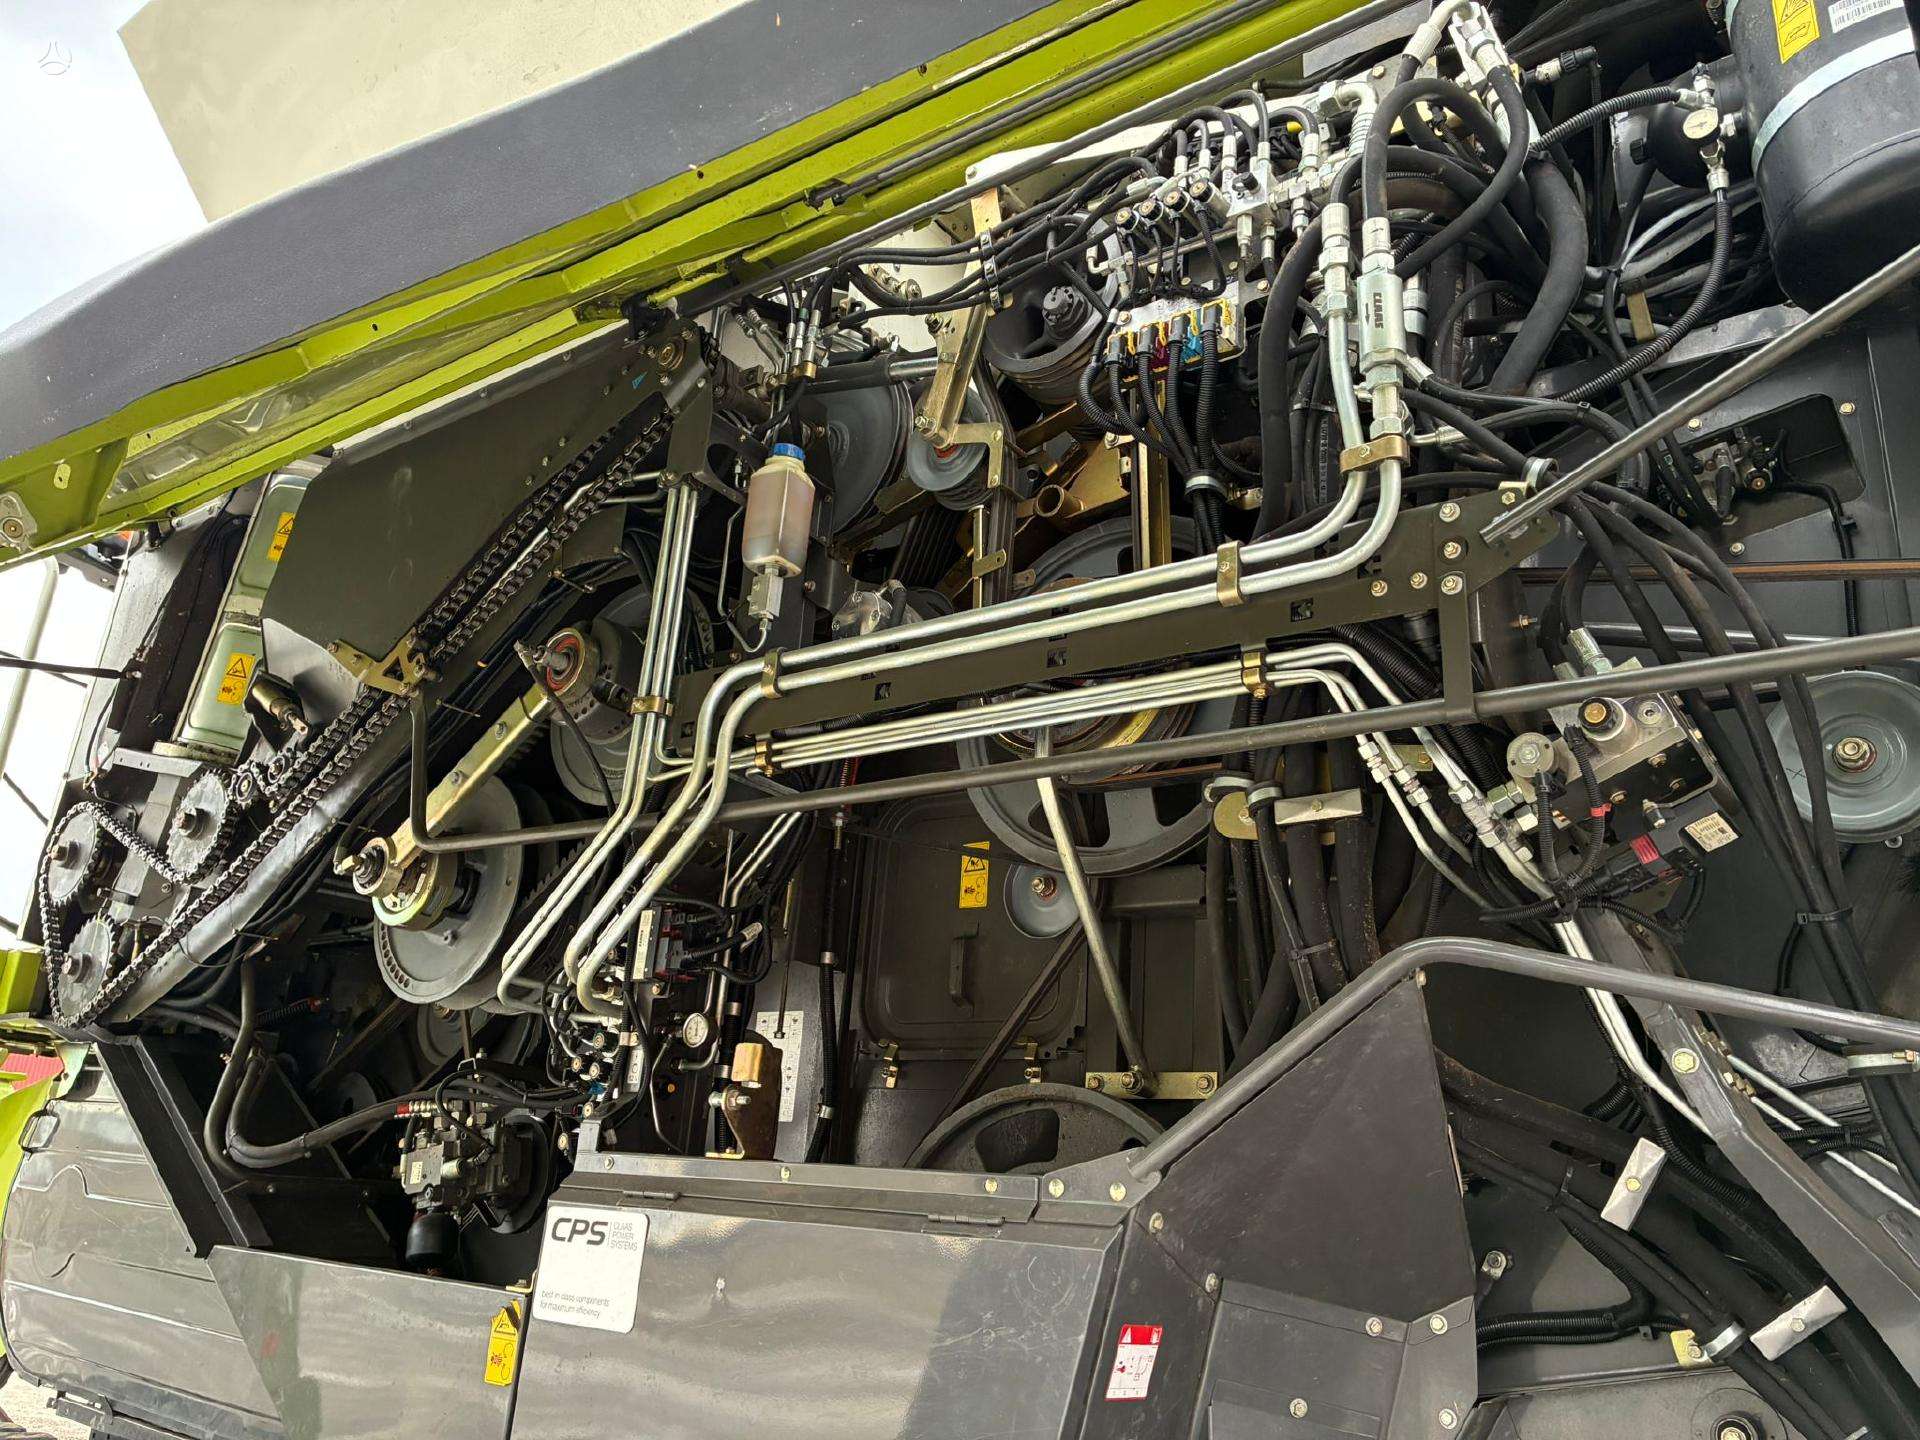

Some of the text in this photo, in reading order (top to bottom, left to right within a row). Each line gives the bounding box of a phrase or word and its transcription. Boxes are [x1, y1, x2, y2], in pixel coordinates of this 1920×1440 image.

[1373, 292, 1384, 329] CLAAS
[552, 1217, 609, 1246] CPS
[612, 1231, 634, 1240] POWER
[610, 1240, 638, 1251] SYSTEMS
[576, 1295, 610, 1307] components
[547, 1303, 575, 1313] maximum
[576, 1306, 601, 1319] efficiency
